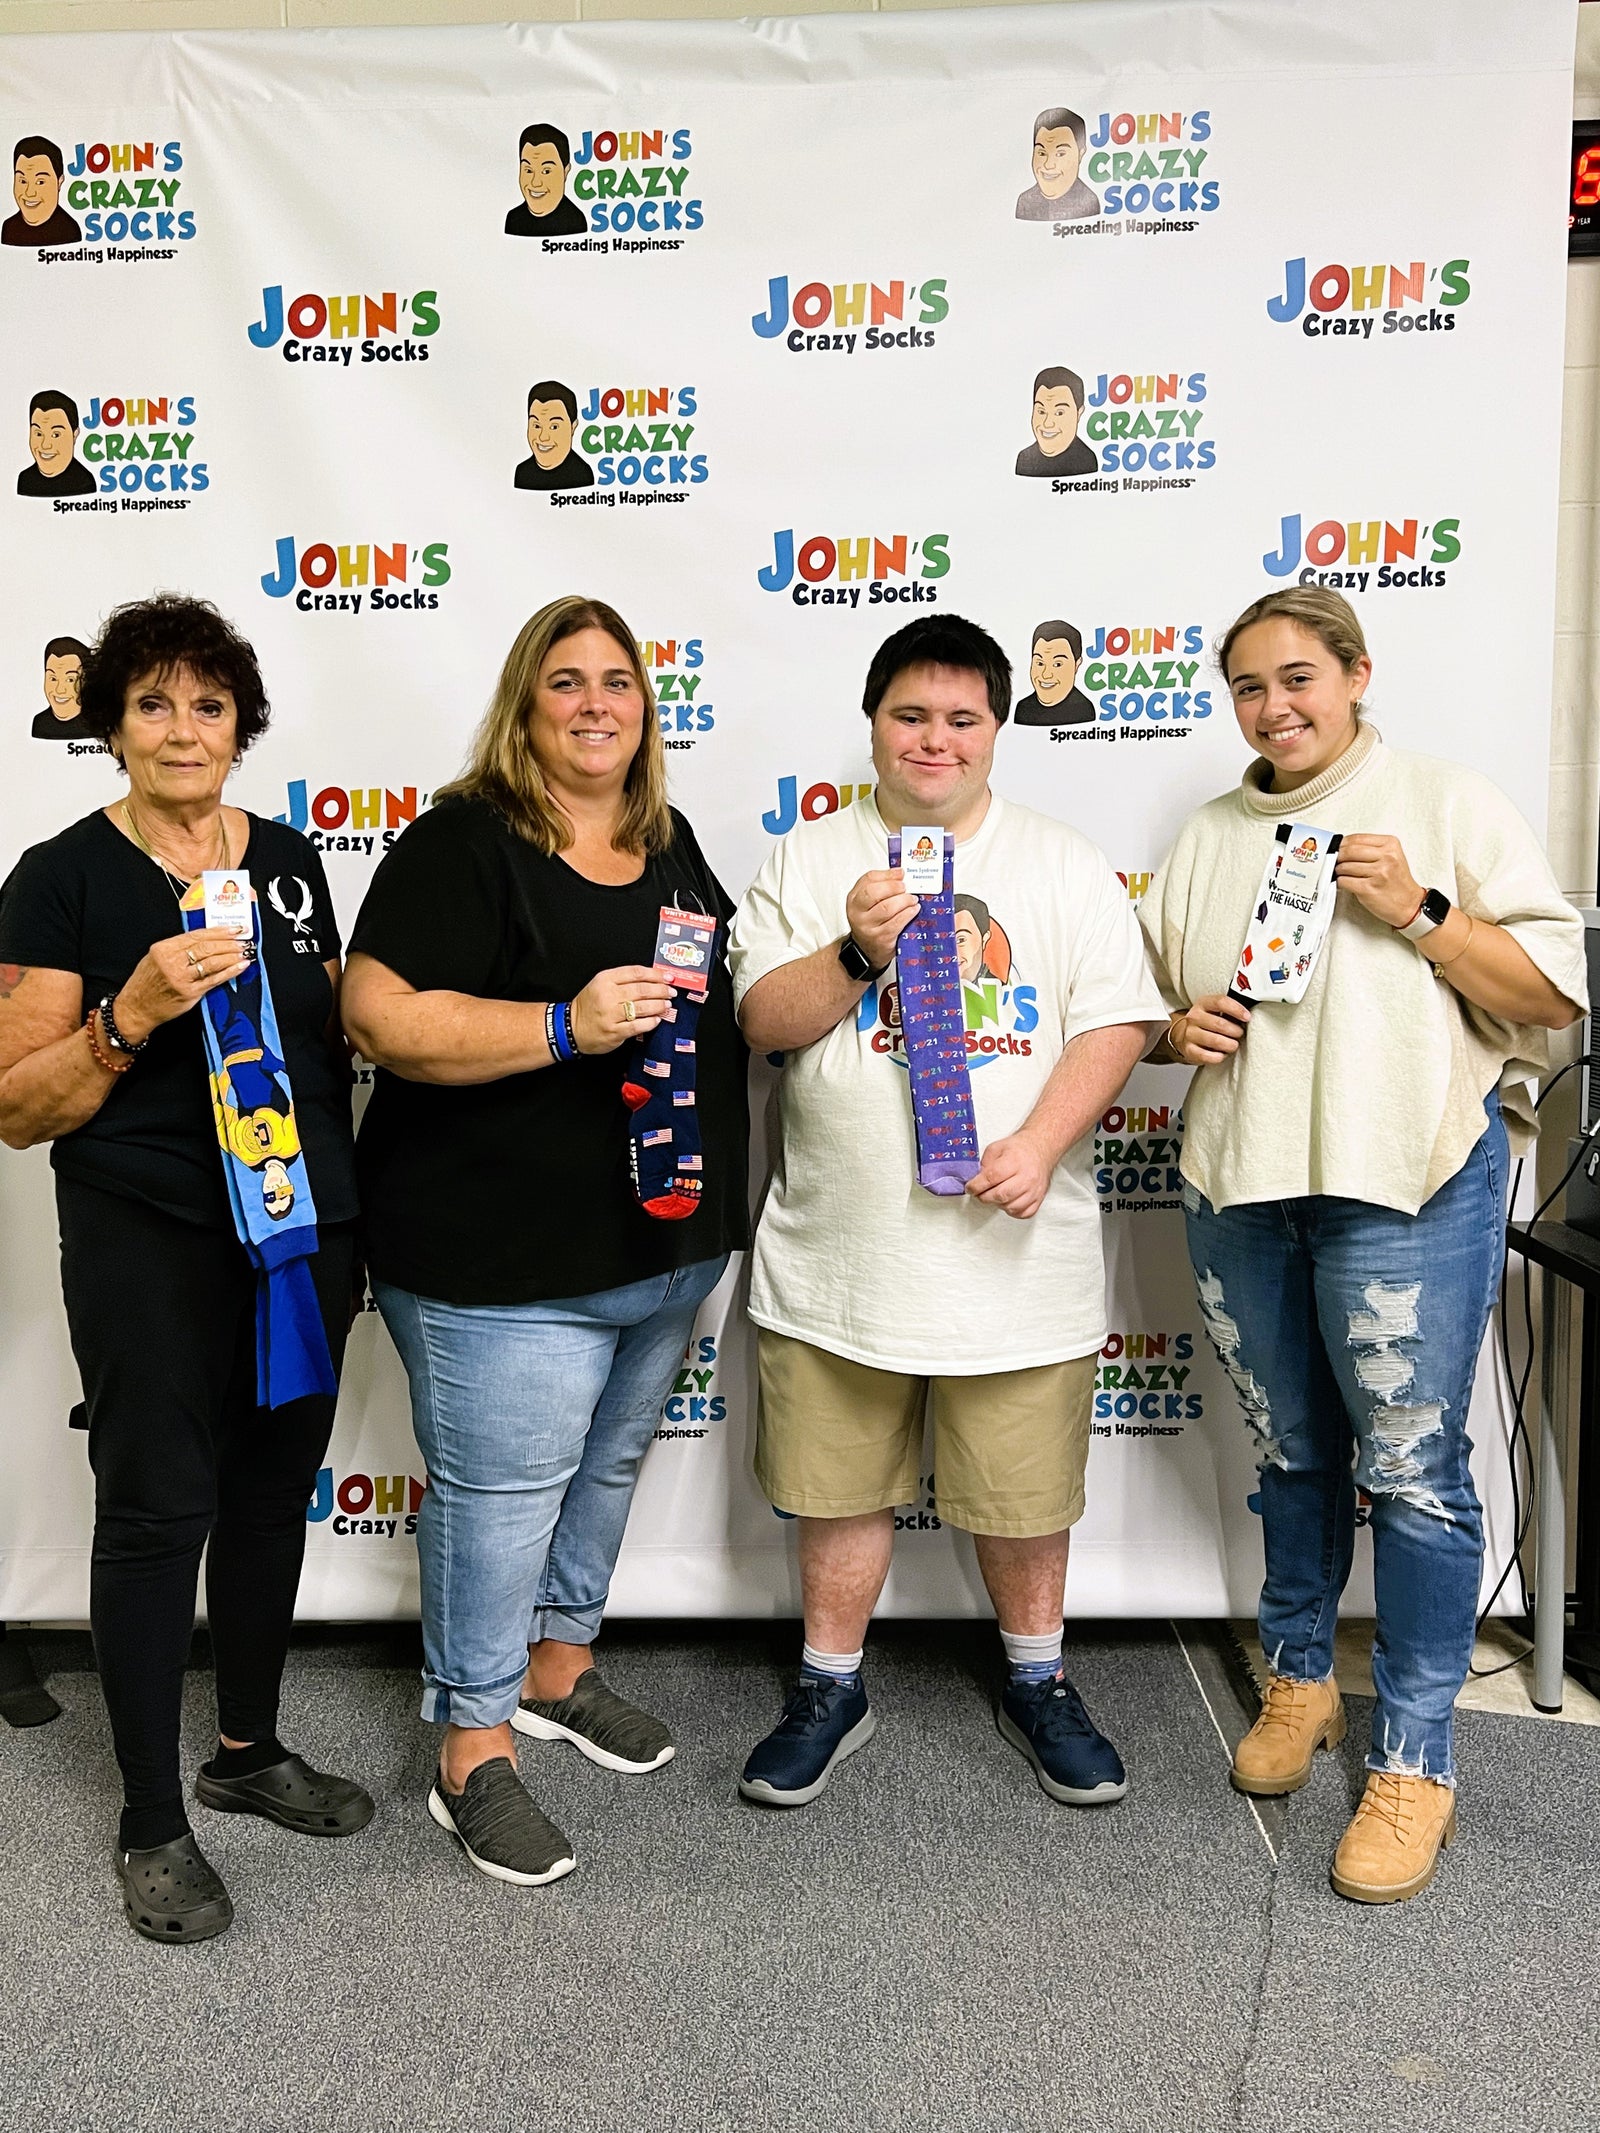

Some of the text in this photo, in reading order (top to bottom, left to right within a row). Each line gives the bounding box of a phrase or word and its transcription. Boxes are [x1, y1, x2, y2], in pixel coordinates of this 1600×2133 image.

[1089, 110, 1211, 146] JOHN'S
[67, 142, 183, 177] JOHN'S
[573, 129, 691, 165] JOHN'S
[1088, 147, 1208, 181] CRAZY
[67, 179, 181, 210] CRAZY
[573, 166, 689, 199] CRAZY
[1103, 180, 1220, 214] SOCKS
[84, 211, 196, 242] SOCKS
[590, 200, 704, 233] SOCKS
[1052, 220, 1122, 238] Spreading
[37, 247, 104, 264] Spreading
[541, 237, 609, 255] Spreading
[1267, 257, 1470, 323] JOHN'S
[248, 285, 441, 349] JOHN'S
[752, 275, 949, 339] JOHN'S
[1303, 308, 1456, 339] Crazy Socks
[282, 339, 430, 367] Crazy Socks
[787, 326, 935, 354] Crazy Socks
[581, 386, 697, 421] JOHN'S
[1088, 372, 1206, 408] JOHN'S
[82, 396, 197, 430] JOHN'S
[1086, 409, 1203, 441] CRAZY
[82, 432, 194, 462] CRAZY
[581, 424, 694, 454] CRAZY
[597, 454, 709, 486] SOCKS
[1101, 441, 1216, 473] SOCKS
[99, 463, 209, 493] SOCKS
[1051, 477, 1119, 494] Spreading
[52, 498, 118, 514] Spreading
[550, 490, 616, 508] Spreading
[1263, 513, 1461, 577] JOHN'S
[260, 536, 451, 599] JOHN'S
[758, 529, 951, 592] JOHN'S
[1299, 565, 1446, 593] Crazy Socks
[295, 588, 439, 614] Crazy Socks
[792, 581, 937, 609] Crazy Socks
[1085, 625, 1203, 659] JOHN'S
[1084, 661, 1199, 691] CRAZY
[1099, 691, 1212, 721] SOCKS
[1050, 727, 1116, 743] Spreading
[308, 830, 375, 856] Crazy
[1269, 891, 1314, 913] THE HASSLE
[965, 1031, 1032, 1056] Socks
[1096, 1167, 1184, 1194] SOCK
[1101, 1333, 1194, 1360] OHN'S
[1095, 1393, 1203, 1420] SOCKS
[333, 1515, 397, 1538] Crazy
